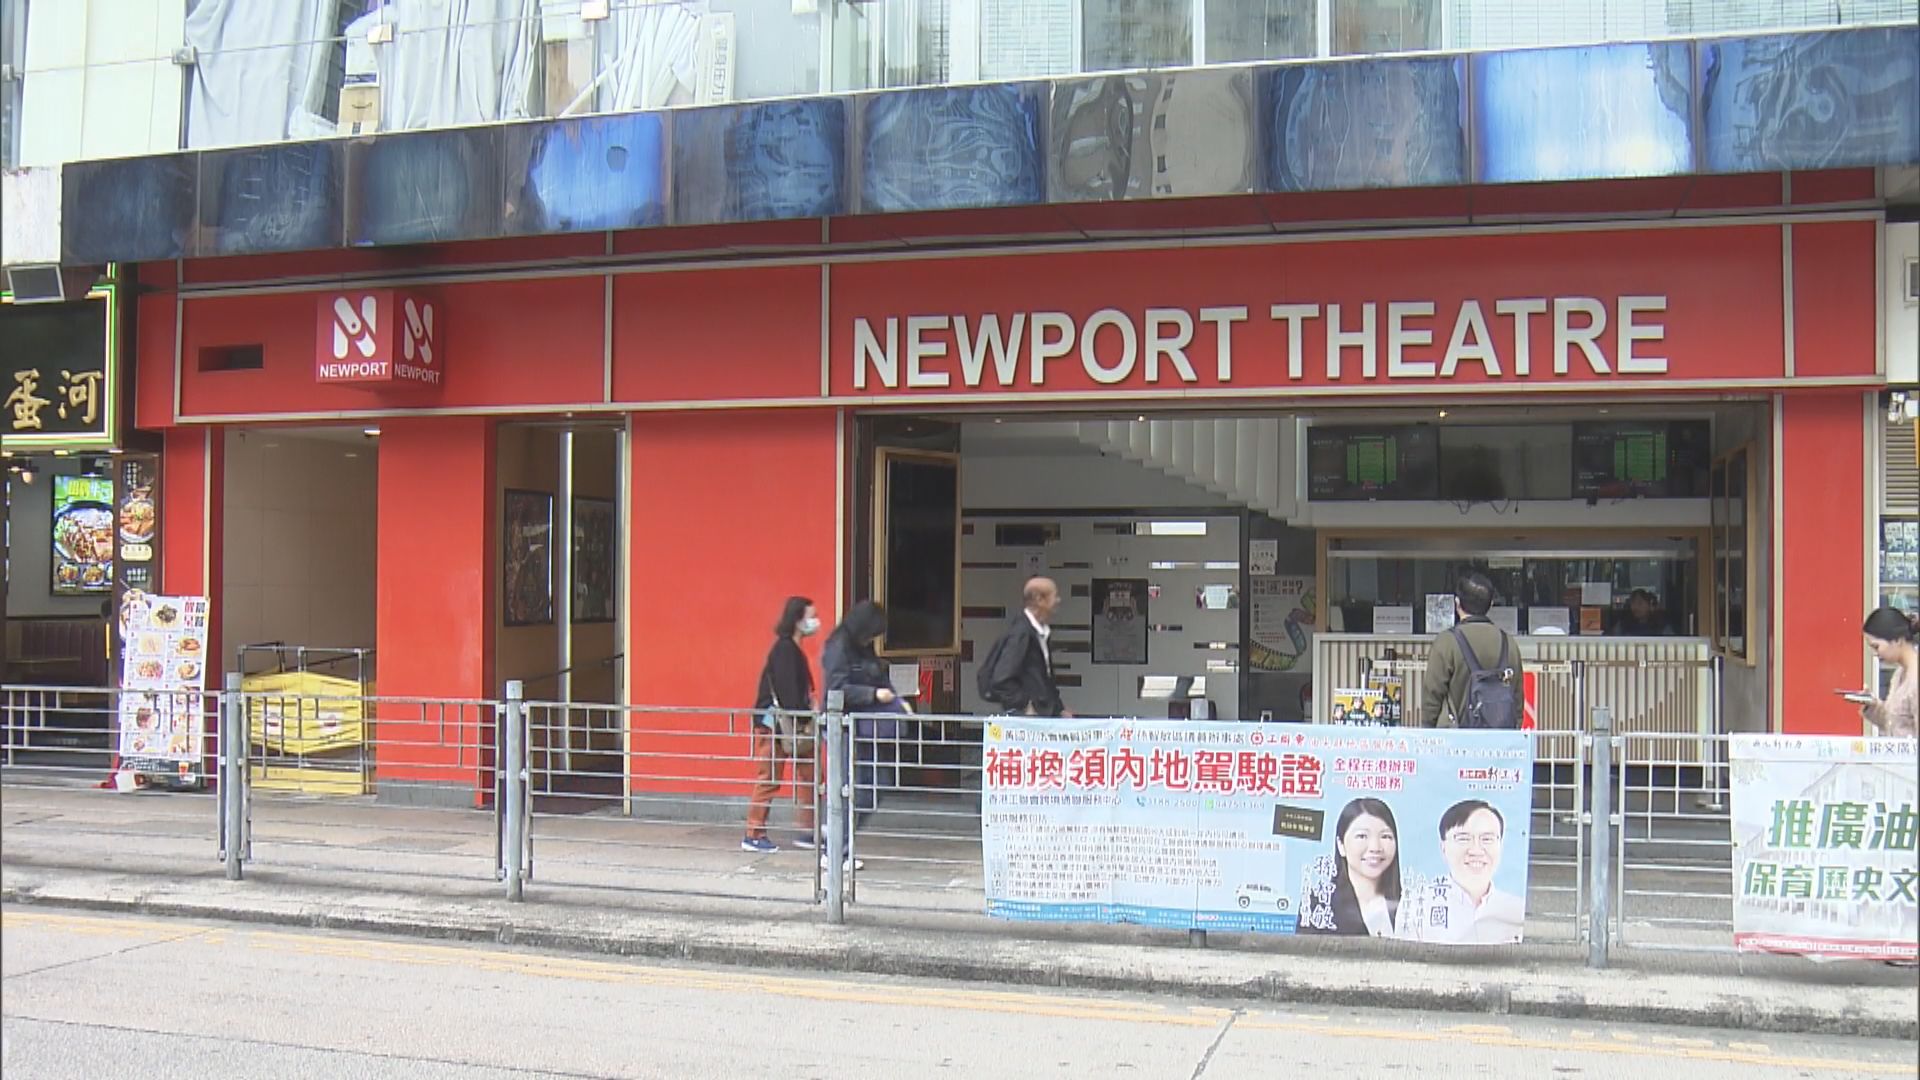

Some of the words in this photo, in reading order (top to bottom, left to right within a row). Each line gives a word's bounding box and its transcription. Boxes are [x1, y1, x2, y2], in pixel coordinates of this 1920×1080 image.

[854, 305, 1248, 389] NEWPORT
[1270, 295, 1668, 380] THEATRE
[320, 361, 389, 378] NEWPORT
[394, 363, 440, 385] NEWPORT
[4, 368, 103, 430] 蛋河
[986, 747, 1322, 795] 補換領內地駕駛證
[1333, 757, 1416, 774] 全程在港辦理
[1767, 799, 1918, 852] 推廣油
[1743, 861, 1918, 903] 保育歷史文
